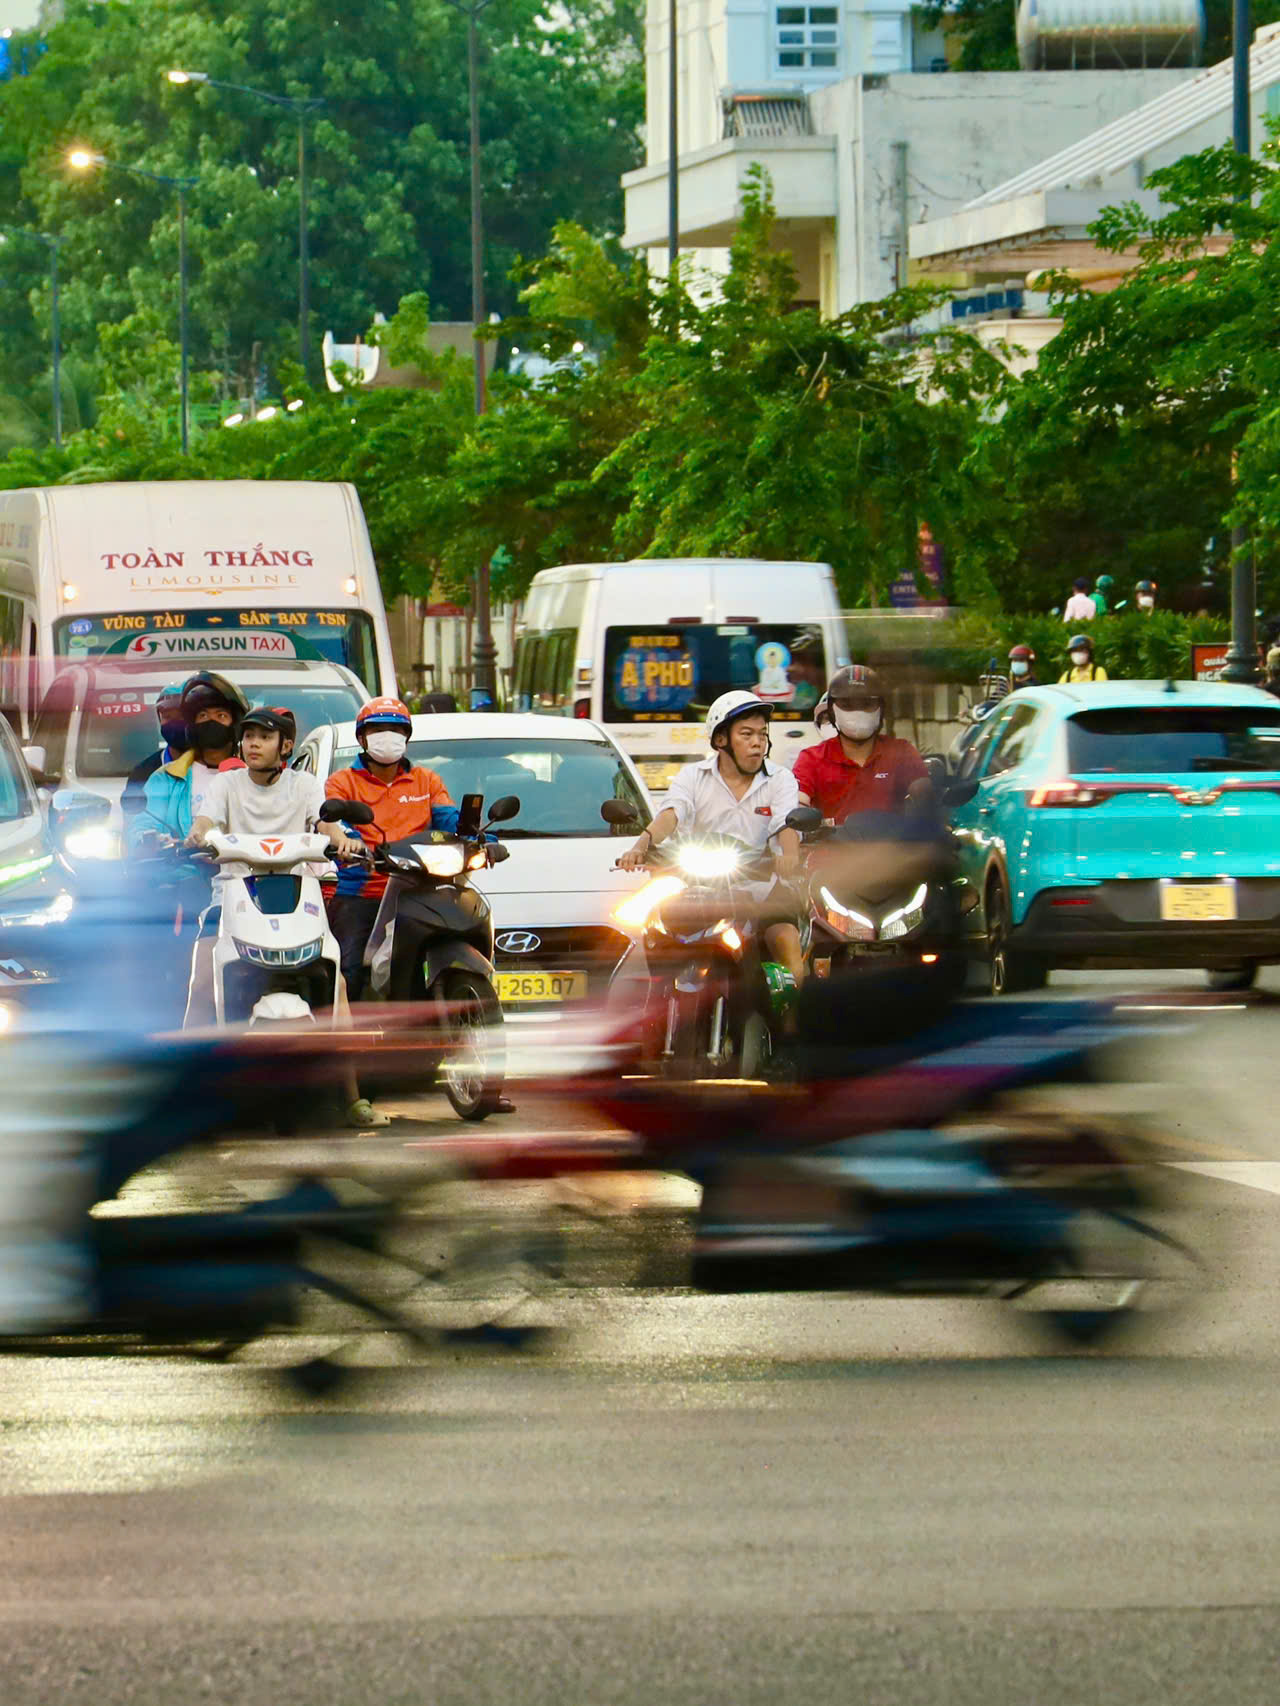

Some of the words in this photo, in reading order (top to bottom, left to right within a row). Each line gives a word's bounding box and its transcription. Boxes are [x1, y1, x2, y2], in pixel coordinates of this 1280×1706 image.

[100, 547, 185, 569] TOÀN
[203, 542, 314, 567] THẮNG
[129, 574, 297, 586] LIMOUSINE
[153, 612, 185, 628] TÀU
[276, 612, 307, 625] BAY
[316, 612, 346, 625] TSN
[164, 637, 247, 652] VINASUN
[250, 636, 286, 651] TAXI
